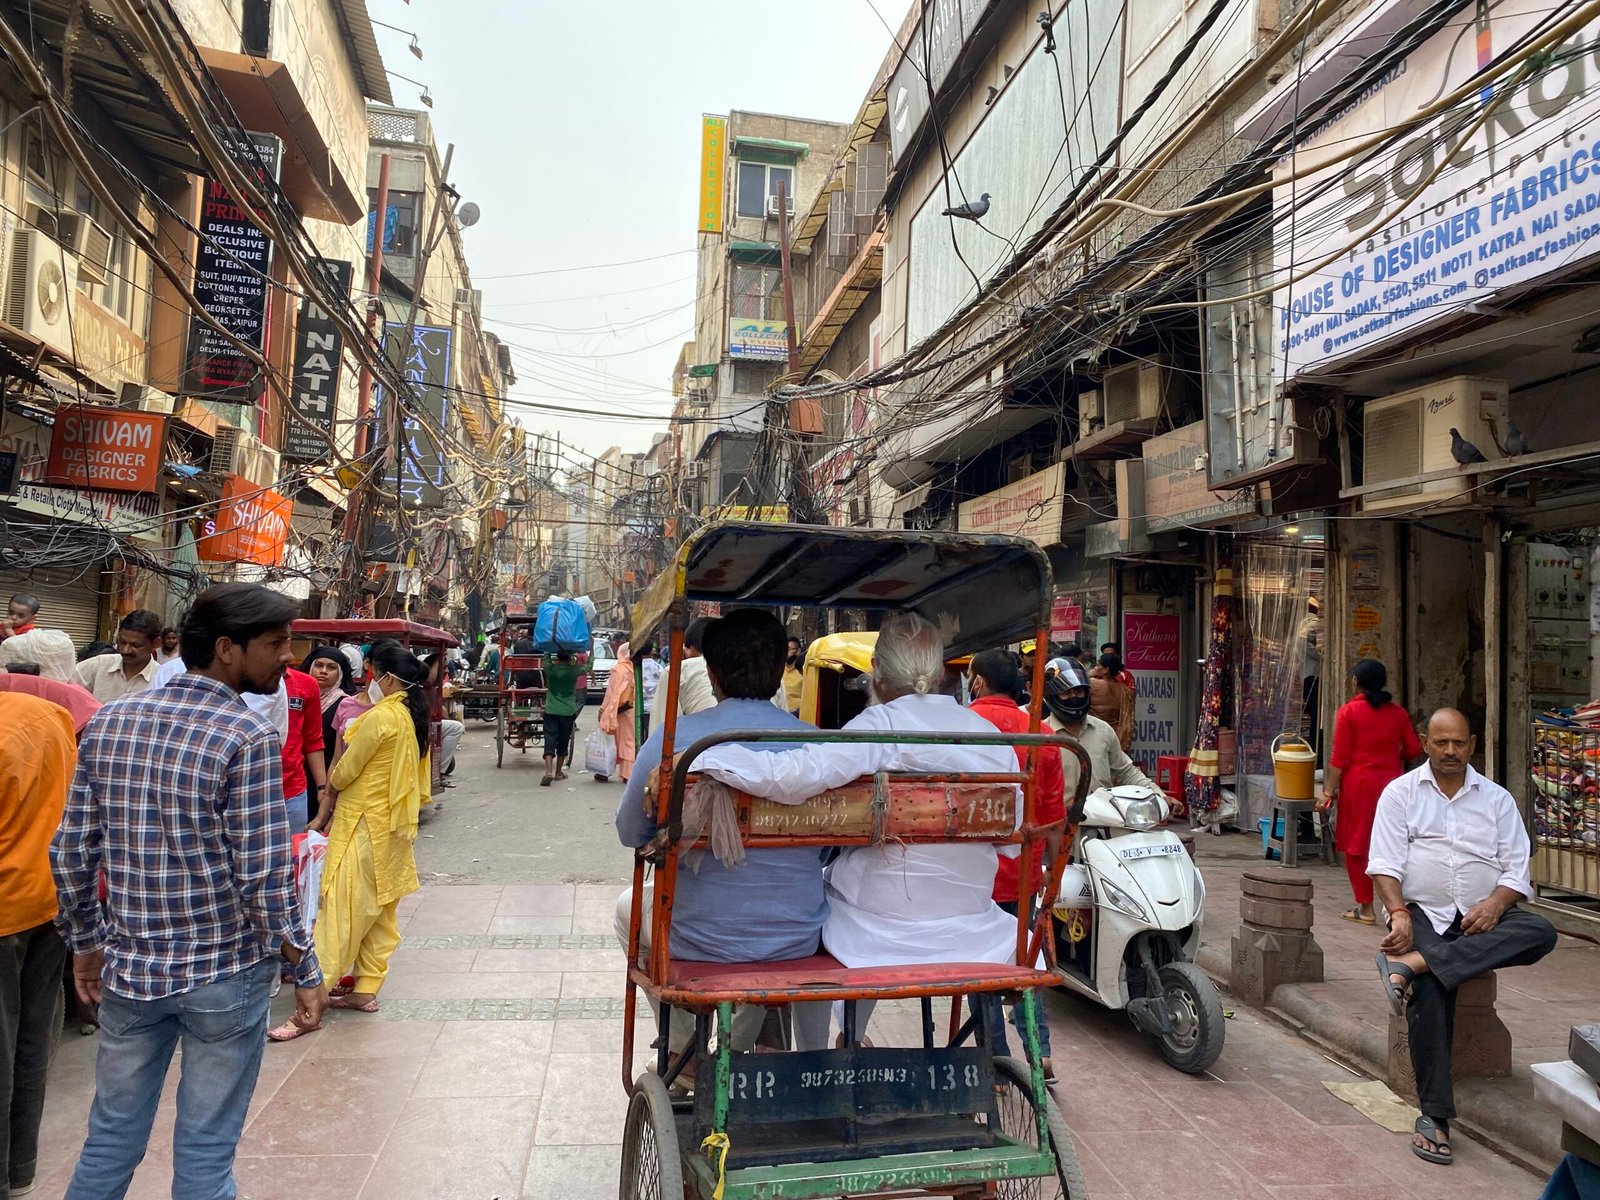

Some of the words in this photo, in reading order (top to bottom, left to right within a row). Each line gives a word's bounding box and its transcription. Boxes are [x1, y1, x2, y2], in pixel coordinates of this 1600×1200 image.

[208, 223, 244, 235] DEALS
[247, 228, 263, 238] IN:
[200, 270, 220, 281] SUIT,
[221, 273, 262, 285] DUPATTAS
[1281, 281, 1334, 330] HOUSE
[1341, 265, 1365, 298] OF
[1374, 206, 1481, 283] DESIGNER
[1326, 313, 1342, 332] NAI
[1344, 296, 1381, 323] SADAK,
[1440, 250, 1472, 279] MOTI
[1478, 227, 1526, 261] KATRA
[1532, 210, 1558, 237] NAI
[197, 281, 238, 294] COTTONS,
[238, 286, 262, 296] SILKS
[198, 328, 213, 336] 770
[63, 417, 152, 448] SHIVAM
[62, 448, 146, 467] DESIGNER
[66, 463, 138, 482] FABRICS
[233, 499, 285, 540] SHIVAM
[1126, 620, 1178, 643] Kathuria
[1127, 645, 1178, 662] Textile
[1147, 703, 1157, 715] &
[1131, 720, 1173, 743] SURAT
